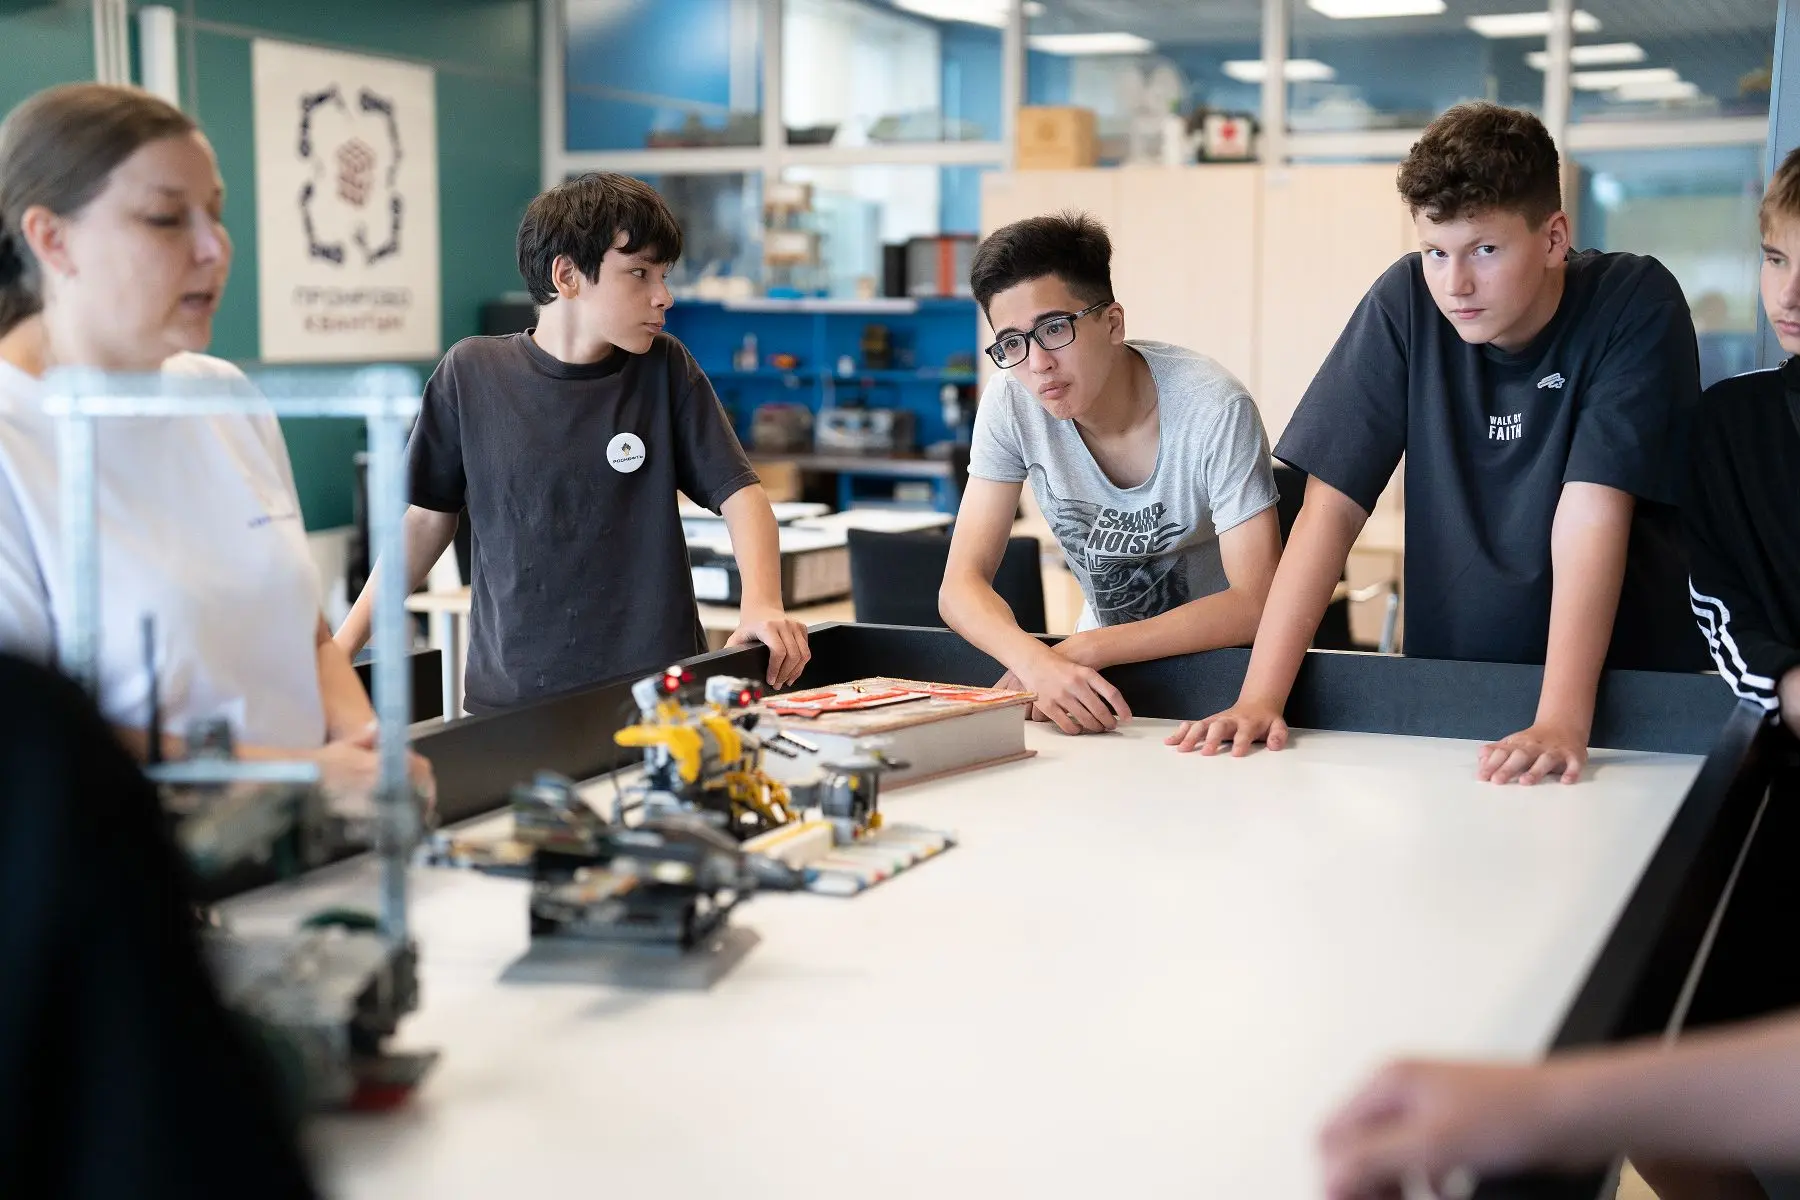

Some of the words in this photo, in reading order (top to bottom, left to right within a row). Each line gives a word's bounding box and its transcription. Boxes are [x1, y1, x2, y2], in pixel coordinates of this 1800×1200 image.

[1489, 415, 1512, 426] WALK
[1513, 413, 1522, 423] BY
[1488, 423, 1522, 441] FAITH
[1099, 501, 1168, 534] SHARP
[1087, 526, 1170, 555] NOISE
